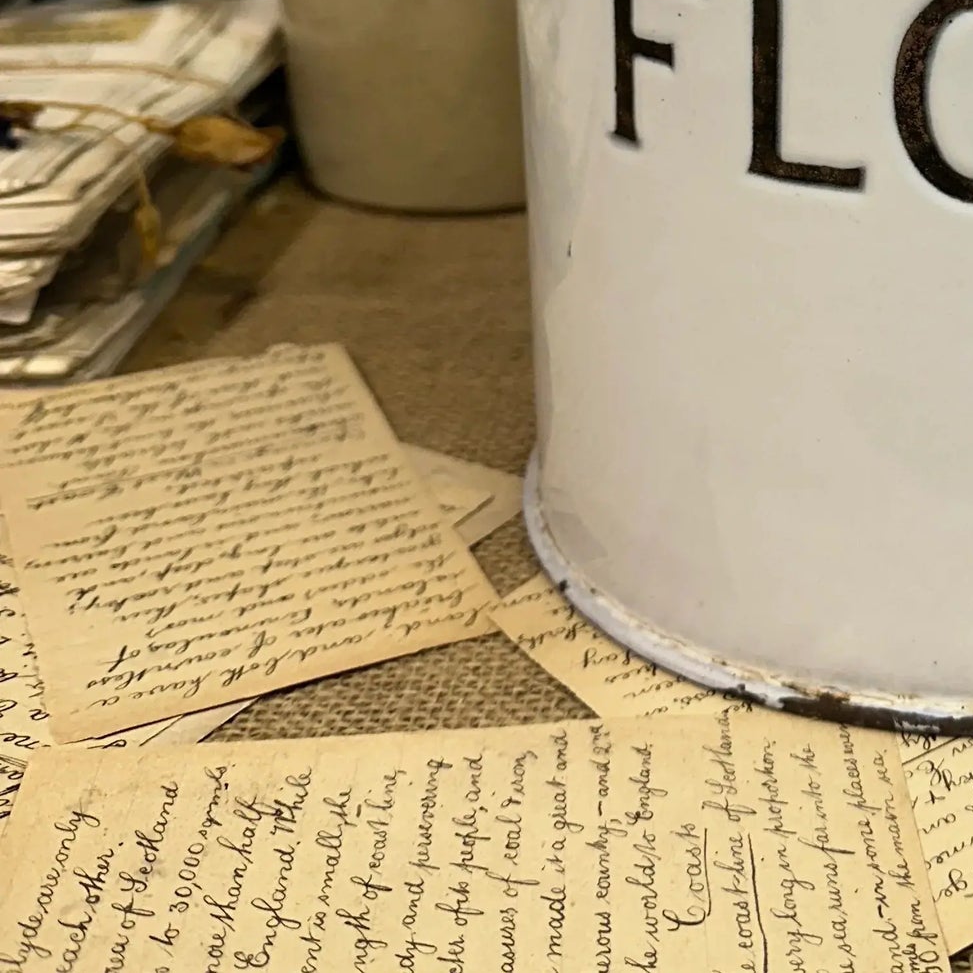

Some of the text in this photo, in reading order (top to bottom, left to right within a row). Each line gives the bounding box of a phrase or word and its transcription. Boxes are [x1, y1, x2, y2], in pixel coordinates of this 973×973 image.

[270, 768, 312, 835] While
[464, 754, 482, 803] and
[842, 758, 881, 815] places
[119, 782, 178, 892] Scotland
[217, 796, 282, 863] half
[408, 758, 452, 873] persevering
[702, 799, 756, 822] of
[307, 911, 326, 930] is
[323, 788, 351, 821] the
[495, 815, 522, 865] coal
[540, 731, 584, 958] made it a great and
[633, 829, 661, 860] to
[760, 845, 791, 873] in
[790, 743, 856, 957] sea runs far into the
[0, 811, 100, 973] lyde are only
[149, 923, 179, 946] to
[169, 843, 202, 912] 30,000
[203, 863, 247, 931] than
[351, 875, 392, 900] of
[486, 873, 539, 897] of
[625, 858, 659, 942] world
[663, 823, 706, 930] Coasts
[770, 873, 814, 926] long
[883, 858, 914, 889] the
[111, 897, 155, 929] of
[402, 877, 424, 929] and
[907, 898, 937, 945] from
